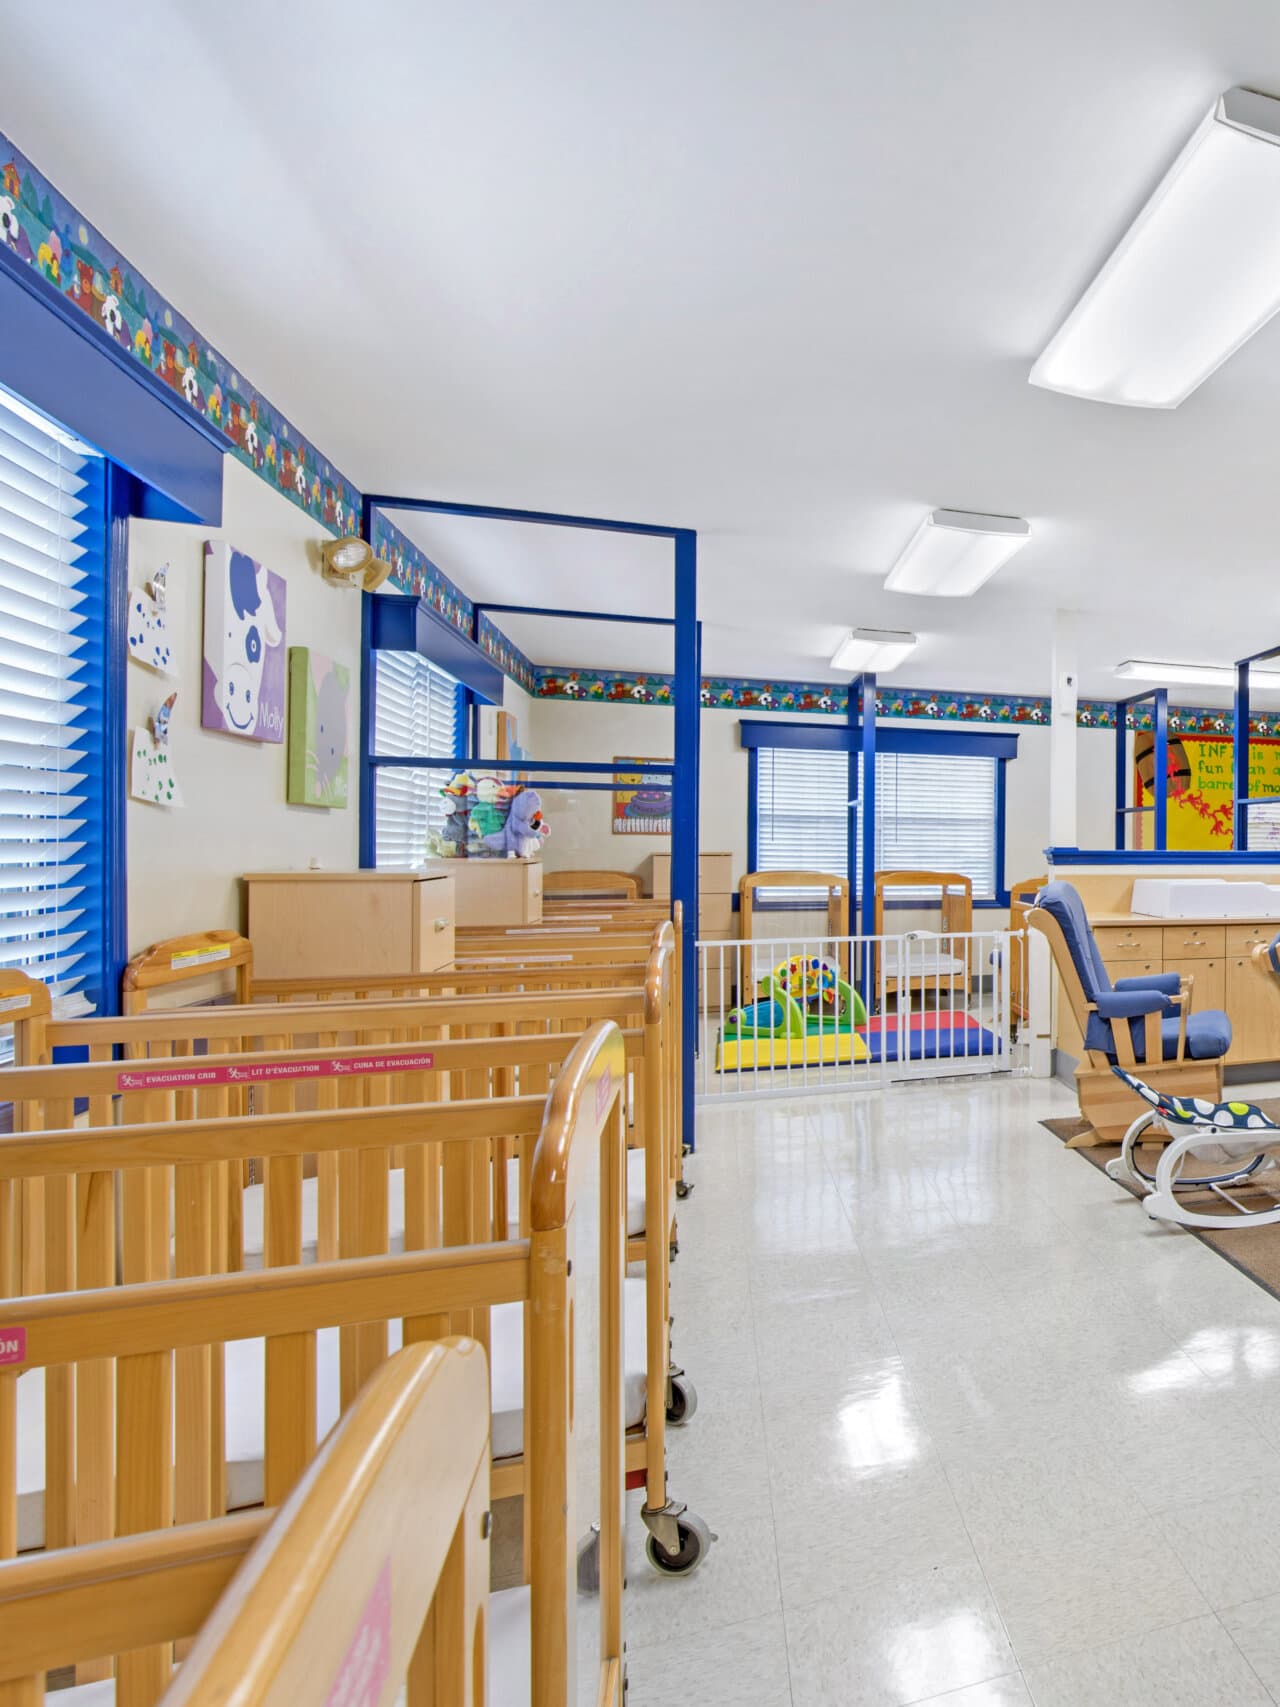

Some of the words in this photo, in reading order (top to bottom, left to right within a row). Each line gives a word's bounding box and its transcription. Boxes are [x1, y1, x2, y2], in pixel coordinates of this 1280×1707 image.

[260, 702, 284, 738] Molly
[1252, 746, 1264, 761] is
[1198, 760, 1224, 774] fun
[1197, 776, 1235, 790] barre
[1248, 780, 1261, 792] of
[146, 1073, 196, 1083] EVACUATION
[197, 1072, 217, 1080] CRIB
[251, 1068, 263, 1076] LIT
[353, 1061, 374, 1070] CUNA
[375, 1060, 385, 1068] DE
[386, 1057, 431, 1067] EVACUACIÓN
